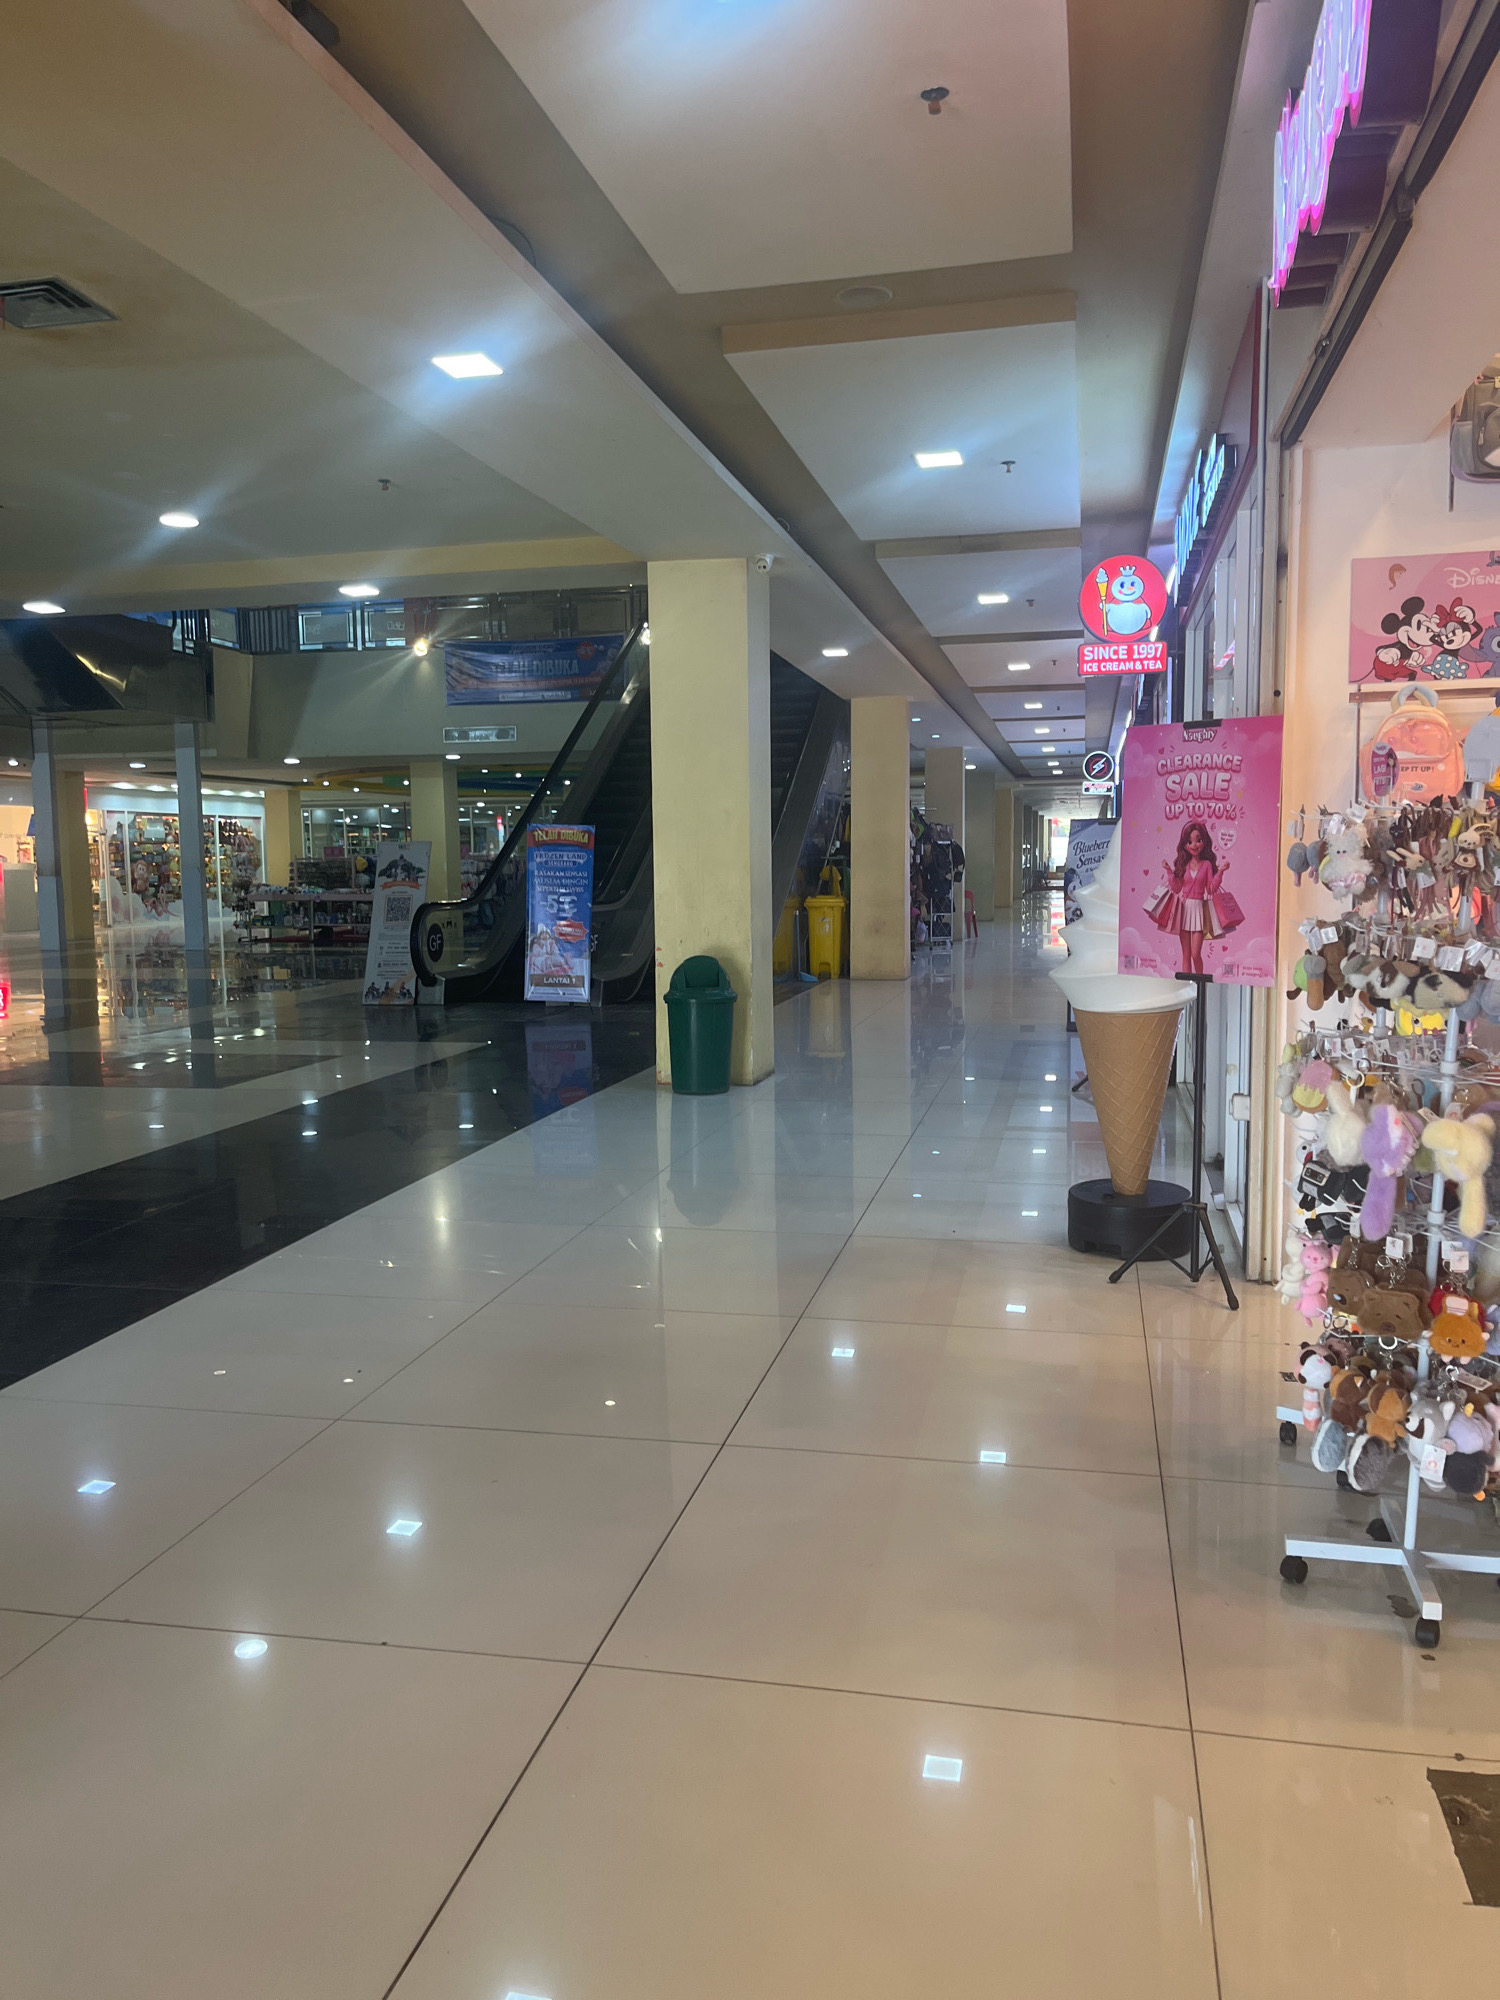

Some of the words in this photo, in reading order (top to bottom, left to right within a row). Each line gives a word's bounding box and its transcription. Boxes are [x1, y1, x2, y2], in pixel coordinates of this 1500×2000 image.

[1084, 646, 1128, 661] SINCE
[1132, 643, 1163, 659] 1997
[532, 659, 579, 675] DIBUKA
[1083, 662, 1099, 672] ICE
[1100, 661, 1134, 671] CREAM
[1135, 661, 1143, 670] &
[1143, 660, 1163, 670] TEA
[1183, 728, 1217, 743] Naughty
[1157, 753, 1243, 775] CLEARANCE
[1165, 772, 1232, 803] SALE
[1165, 804, 1184, 820] UP
[1186, 802, 1205, 818] TO
[1207, 802, 1237, 820] 70%
[533, 829, 558, 842] TELAH
[560, 829, 589, 843] DIBUKA
[1073, 839, 1111, 856] Blueberr
[535, 852, 564, 861] FROZEN
[566, 852, 587, 861] LAND
[1076, 854, 1105, 869] Sensas
[429, 935, 442, 952] GF
